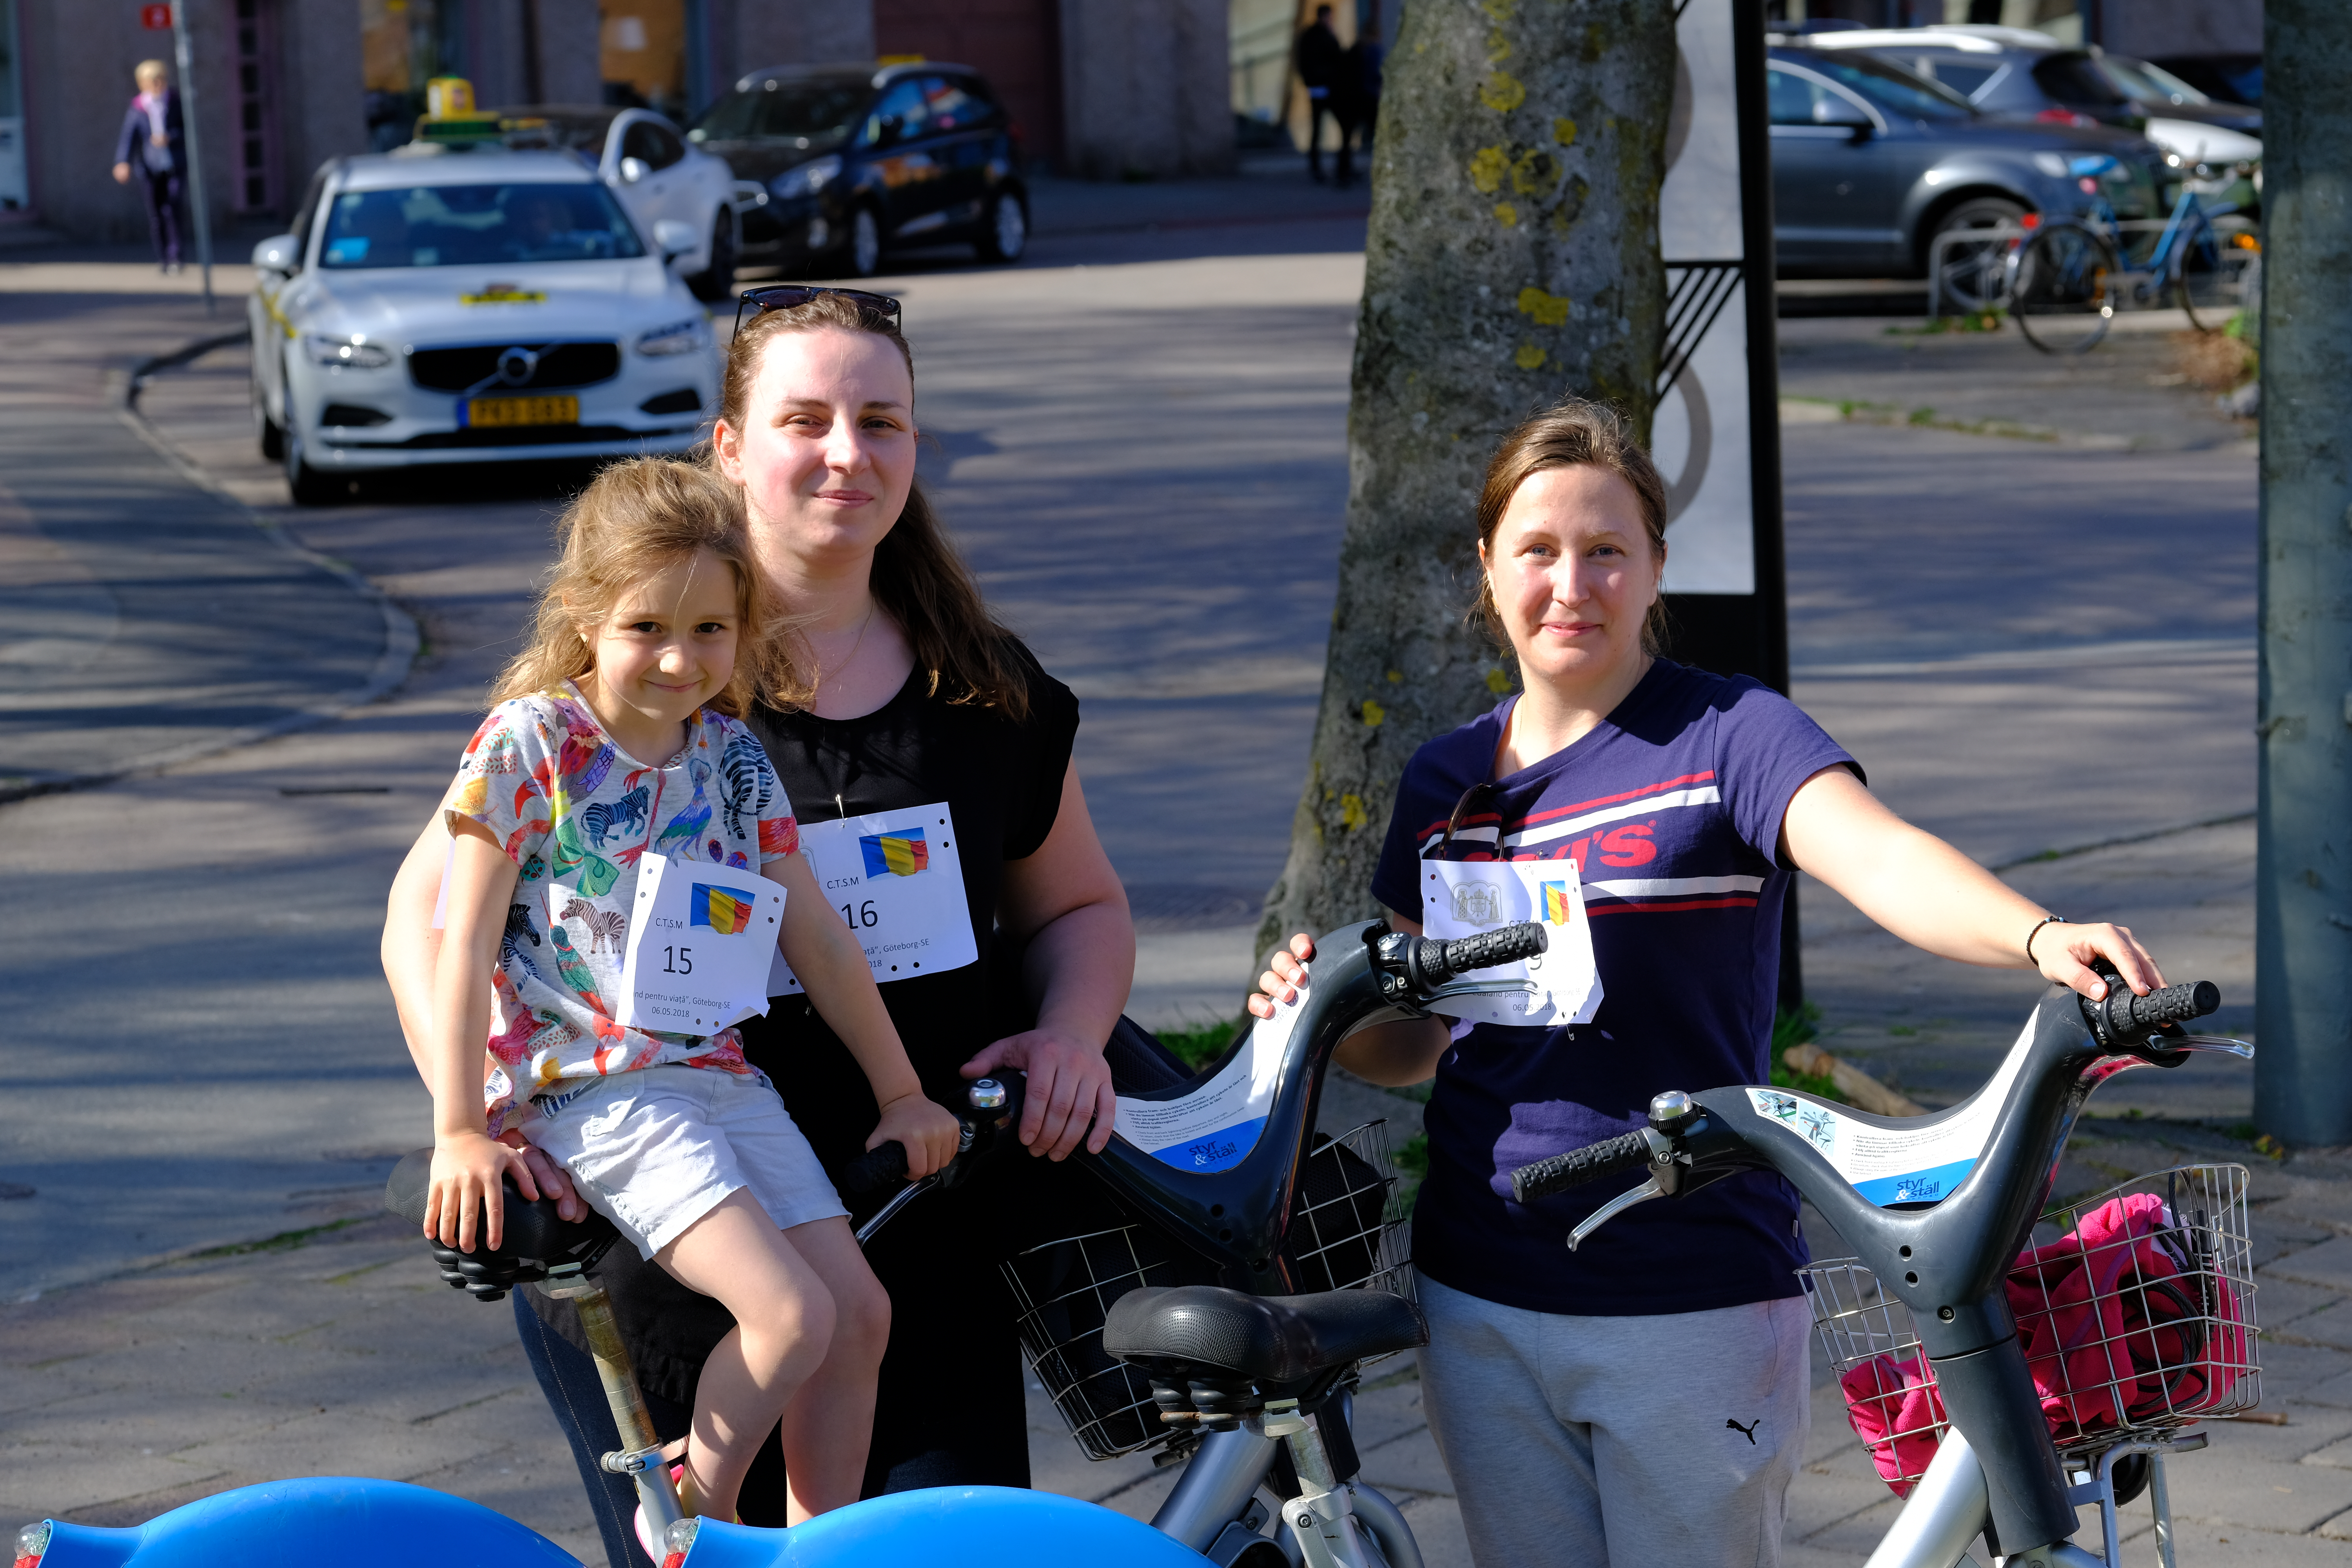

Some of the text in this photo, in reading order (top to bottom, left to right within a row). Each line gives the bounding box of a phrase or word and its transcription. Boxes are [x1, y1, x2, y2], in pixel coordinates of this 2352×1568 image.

[827, 877, 859, 889] C.T.S.M
[842, 900, 878, 929] 16
[656, 918, 682, 929] C.T.S.M
[883, 938, 929, 952] Göteborg-SE
[663, 946, 692, 975] 15
[645, 992, 667, 1001] pentru
[693, 997, 731, 1009] Göteborg-SE
[1513, 1003, 1552, 1011] 06.05.2018
[652, 1006, 690, 1018] 06.05.2018
[1189, 1141, 1216, 1156] styr
[1195, 1142, 1237, 1165] & ställ
[1895, 1181, 1940, 1201] & ställ
[1896, 1177, 1927, 1191] styr
